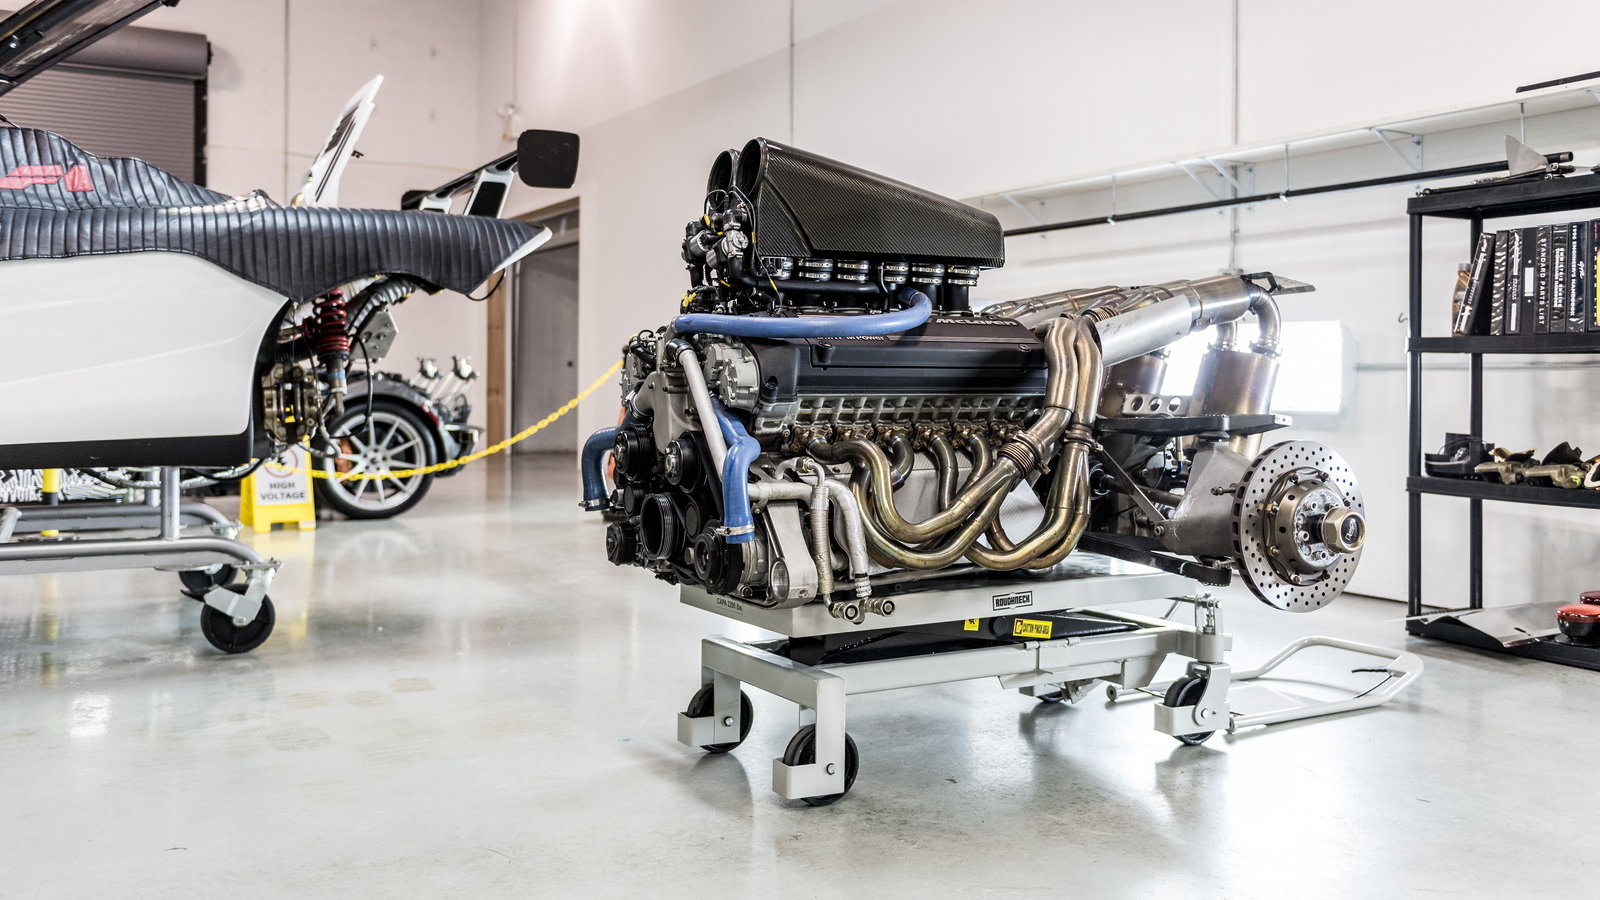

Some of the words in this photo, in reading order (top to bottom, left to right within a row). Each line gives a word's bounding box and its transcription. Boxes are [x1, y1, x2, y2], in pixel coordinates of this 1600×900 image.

[1539, 238, 1547, 278] STANDARD
[936, 318, 1017, 326] McLaren
[260, 492, 305, 500] VOLTAGE
[996, 594, 1030, 607] ROUGHNECK
